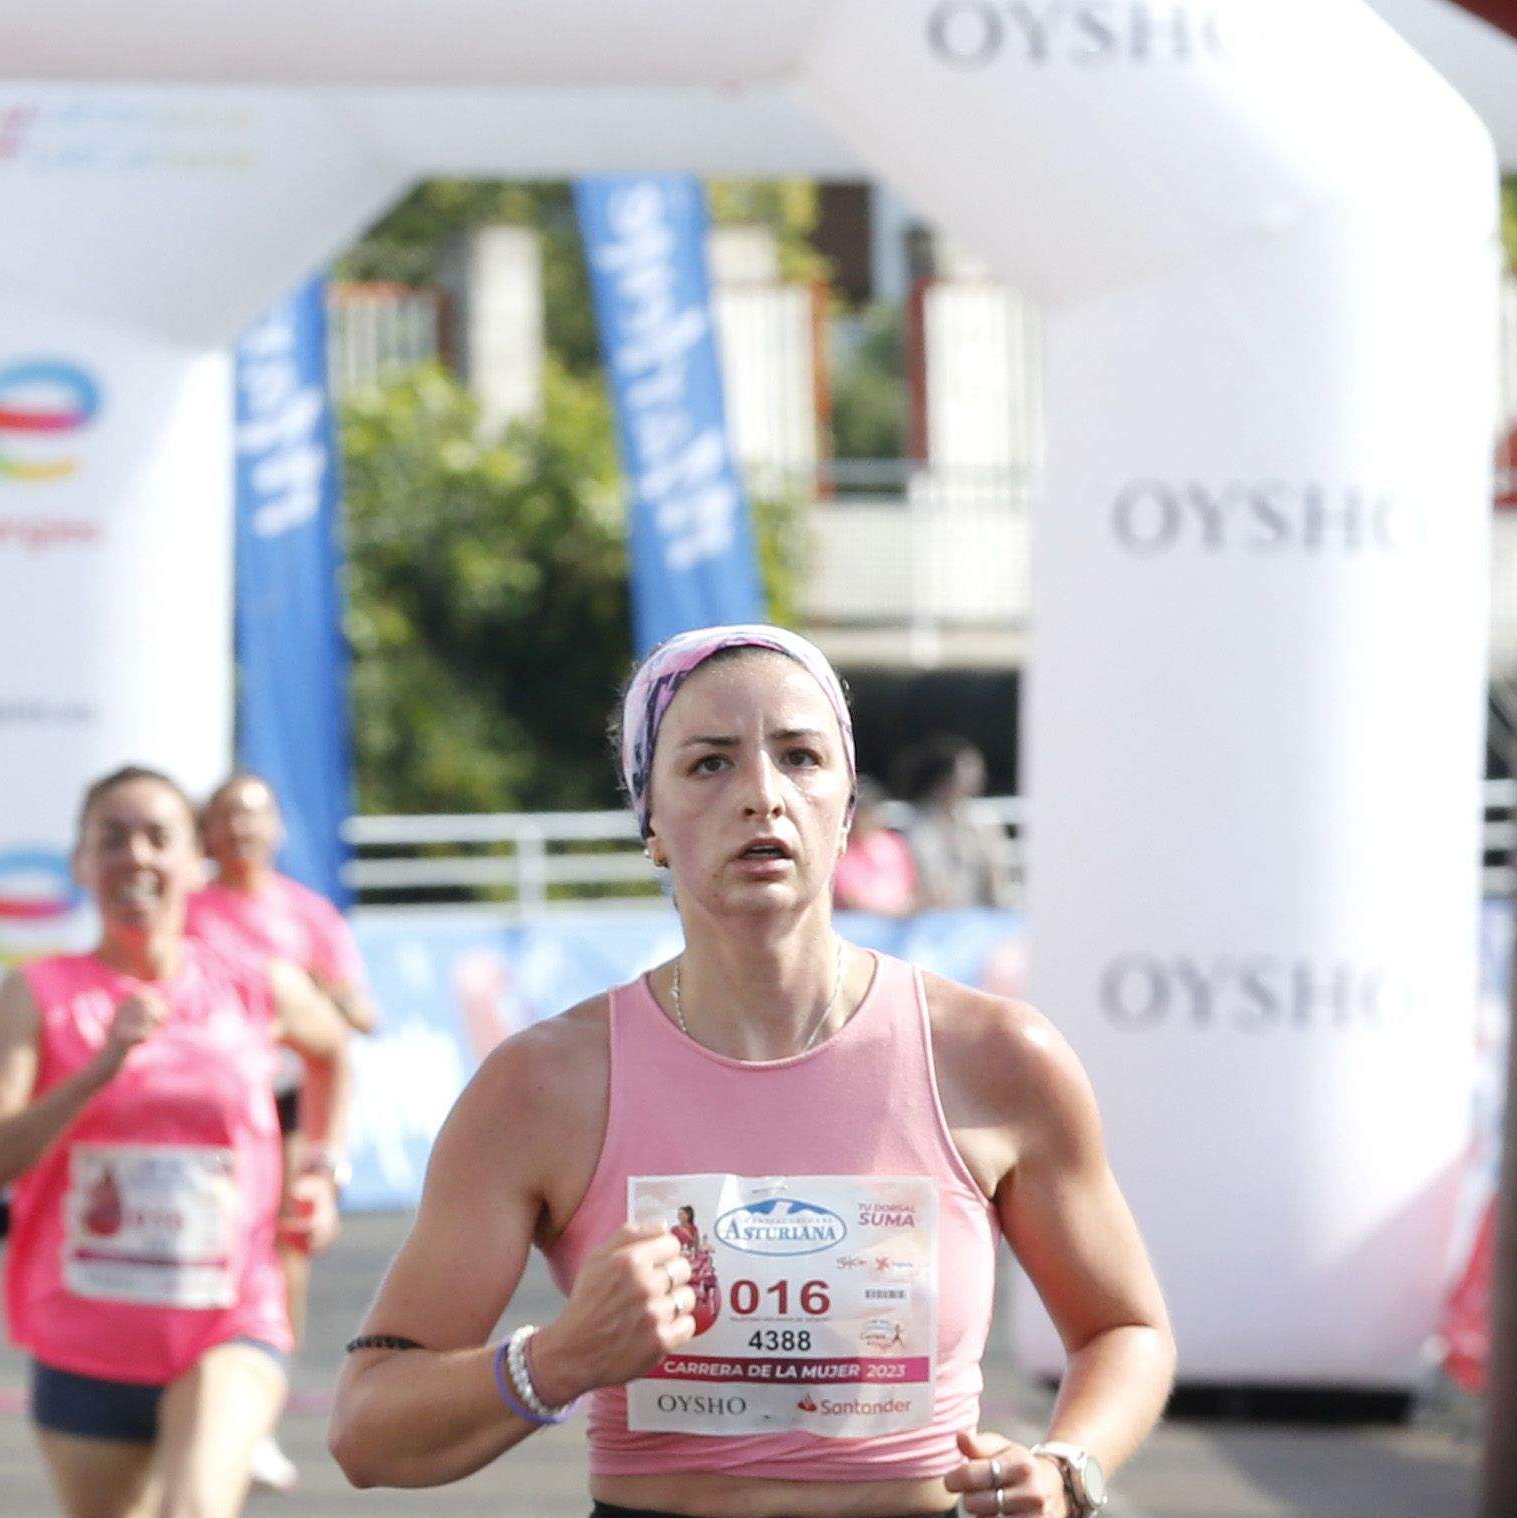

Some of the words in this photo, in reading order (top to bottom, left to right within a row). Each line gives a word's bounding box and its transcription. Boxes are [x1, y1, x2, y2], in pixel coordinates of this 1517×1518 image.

[724, 1219, 836, 1241] ASTURIANA
[858, 1212, 915, 1228] SUMA
[730, 1279, 831, 1315] 016
[748, 1330, 811, 1352] 4388
[664, 1361, 743, 1376] CARRERA
[748, 1365, 772, 1377] DE
[775, 1365, 797, 1378] LA
[801, 1364, 860, 1378] MUJER
[867, 1364, 906, 1378] 2023
[657, 1394, 746, 1415] OYSHO
[821, 1398, 911, 1415] Santander
